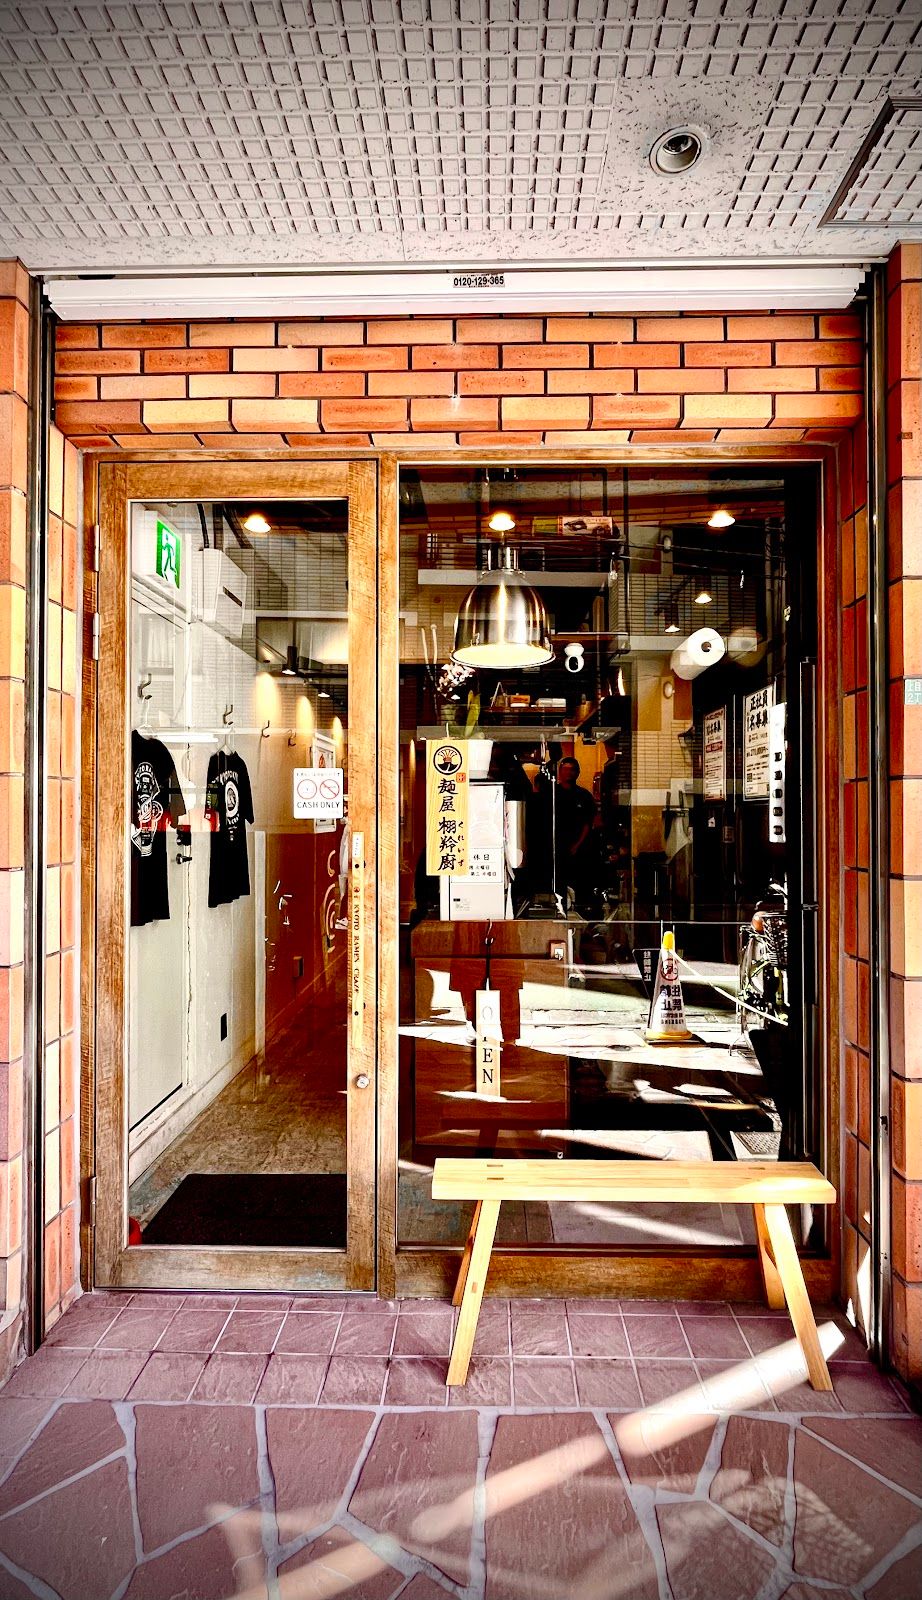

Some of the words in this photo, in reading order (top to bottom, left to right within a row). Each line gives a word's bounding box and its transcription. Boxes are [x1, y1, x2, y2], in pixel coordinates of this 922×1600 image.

[297, 801, 318, 809] CASH
[320, 801, 340, 809] ONLY
[437, 777, 459, 813] 麺屋
[482, 1005, 494, 1084] OEN
